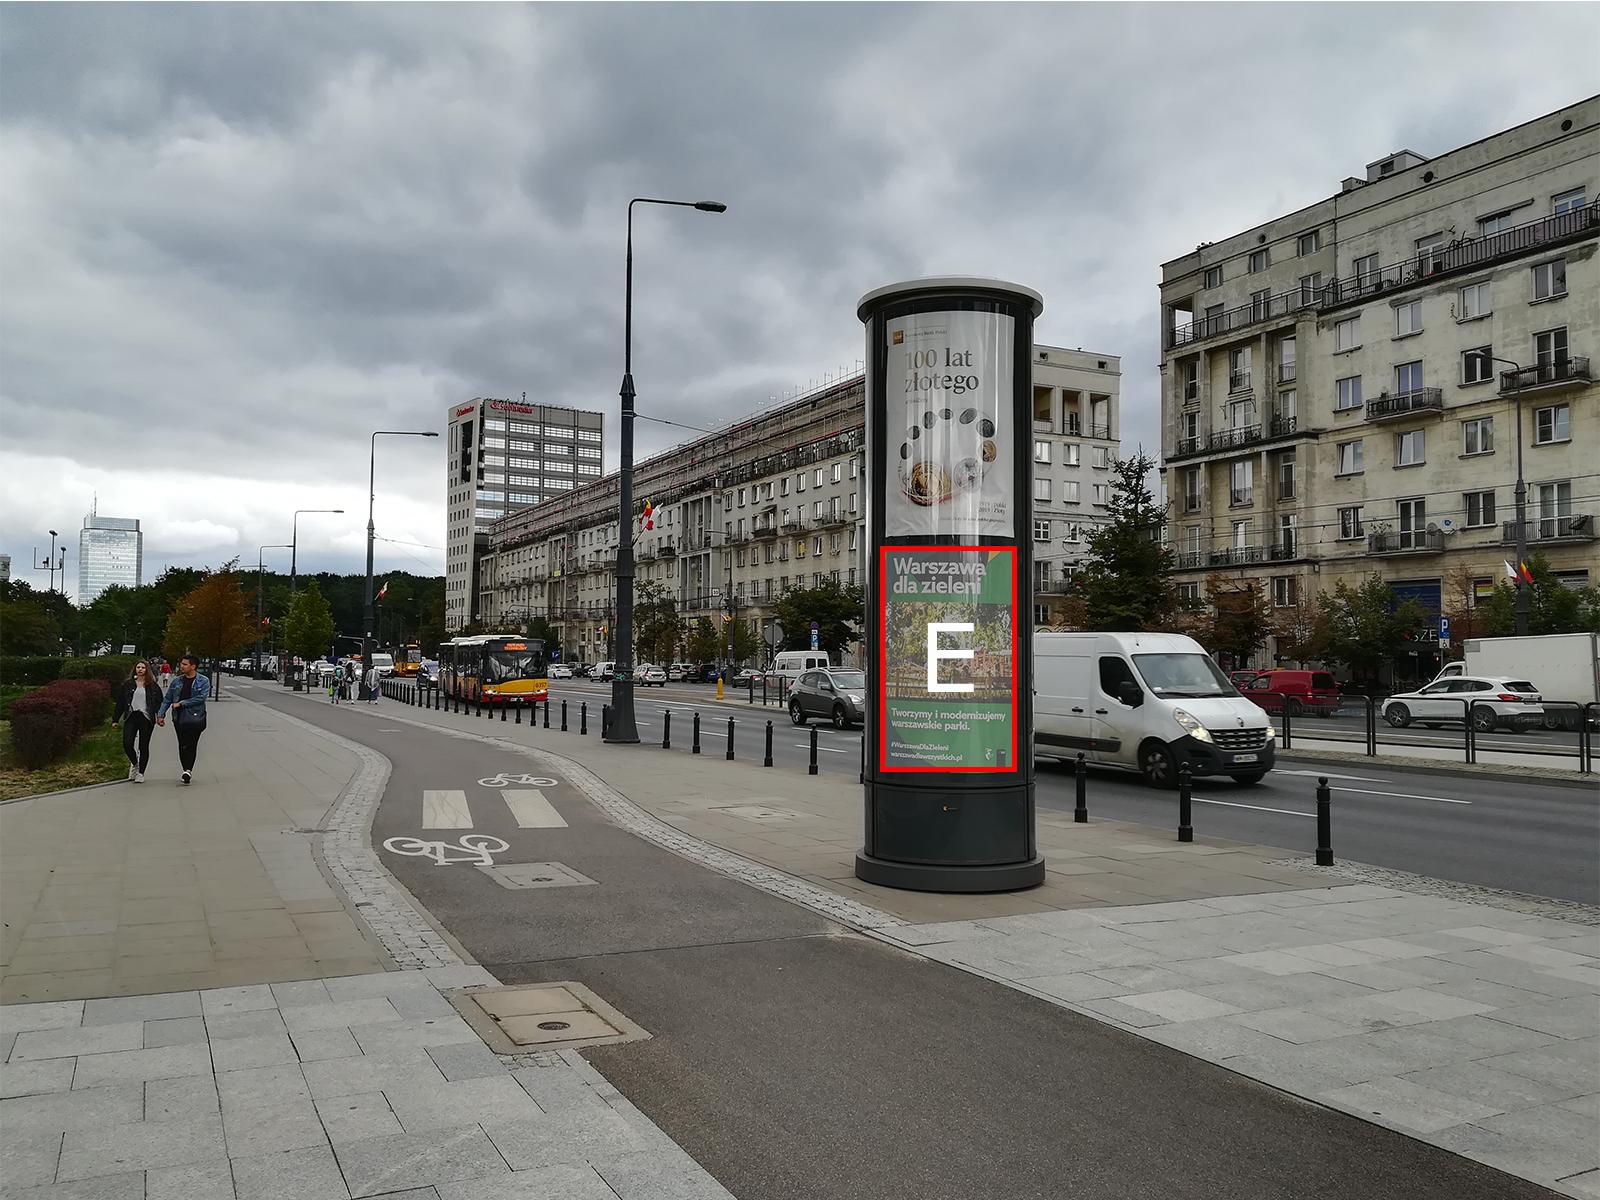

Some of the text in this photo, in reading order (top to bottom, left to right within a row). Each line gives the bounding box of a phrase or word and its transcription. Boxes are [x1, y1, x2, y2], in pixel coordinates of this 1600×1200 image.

[905, 347, 973, 369] 100 lat
[905, 372, 979, 394] złotego
[893, 557, 987, 576] Warszawa
[893, 576, 982, 594] dla zieleni
[1441, 619, 1449, 632] P
[891, 708, 1006, 722] Tworzymy i modernizujemy
[891, 720, 970, 732] warszawskie parki.
